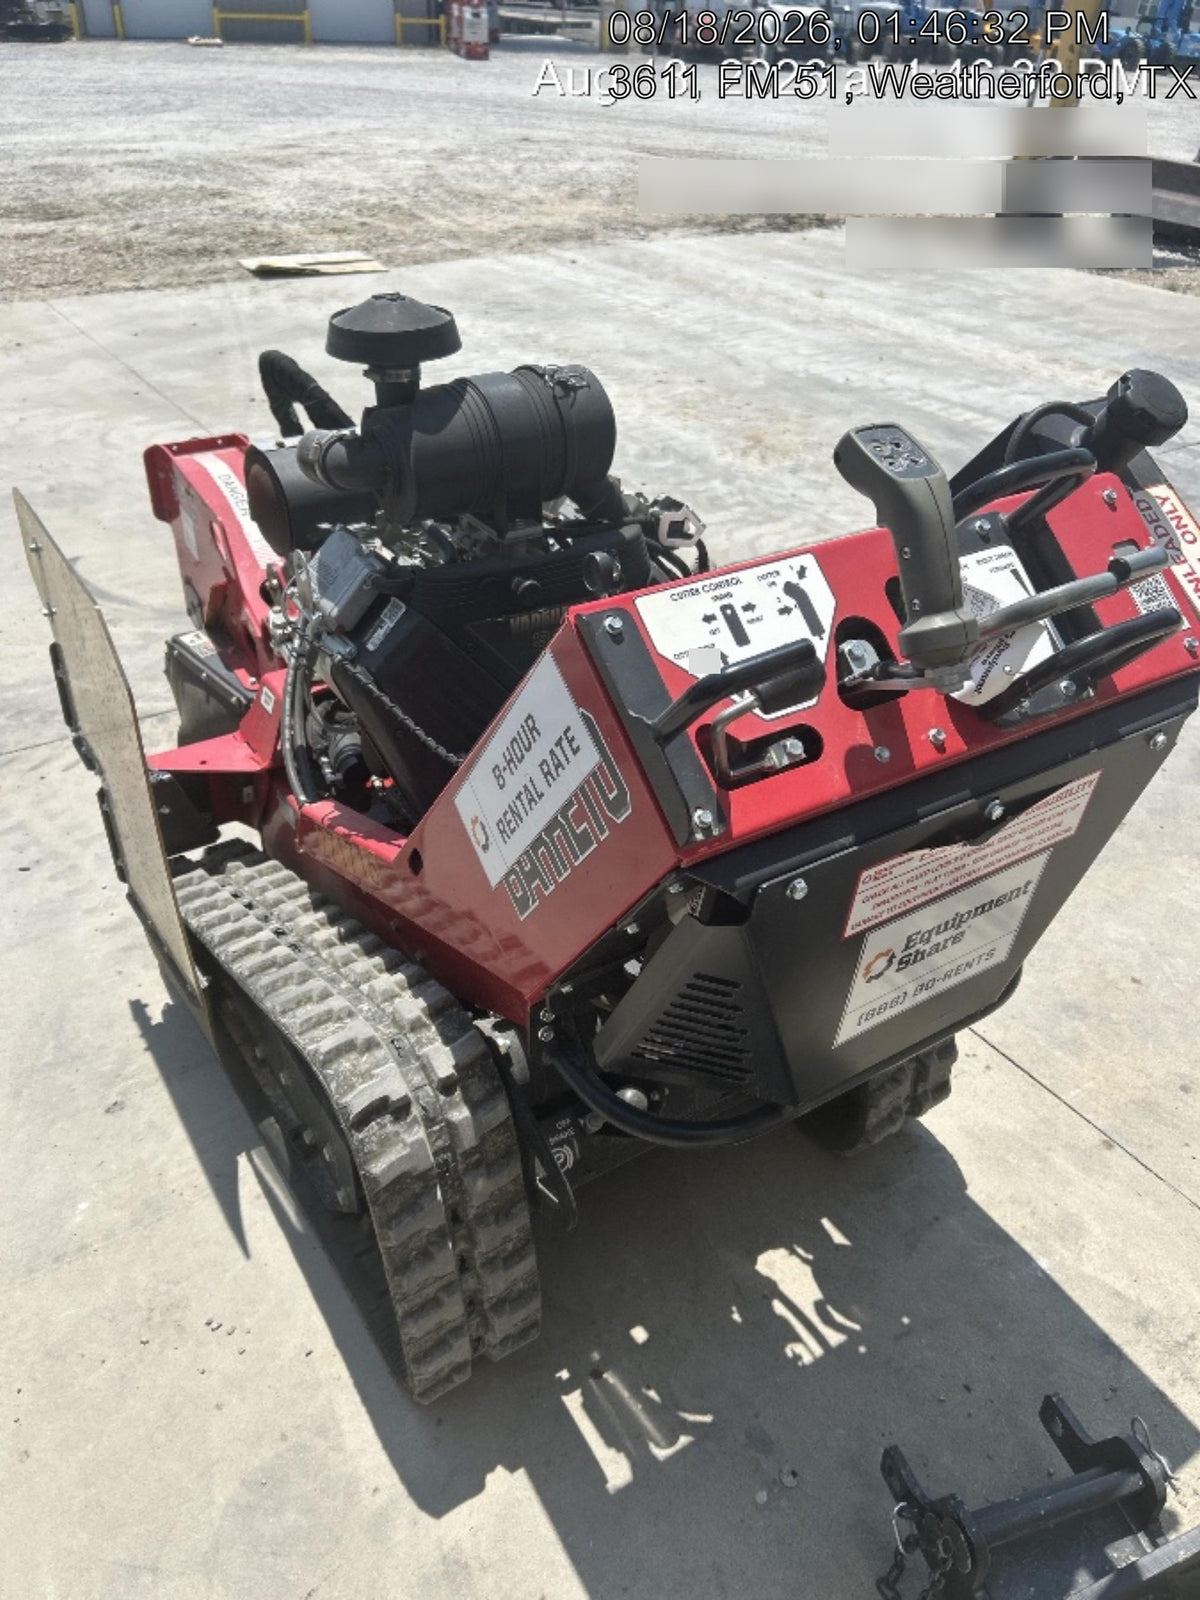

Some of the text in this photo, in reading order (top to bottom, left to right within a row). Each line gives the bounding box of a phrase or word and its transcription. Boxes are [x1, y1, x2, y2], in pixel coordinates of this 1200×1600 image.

[1155, 494, 1198, 545] ONLY
[491, 712, 542, 791] 8-HOUR
[495, 724, 581, 846] RENTAL RATE
[895, 930, 966, 974] Share
[903, 879, 1034, 953] Equipment
[857, 947, 997, 1027] (888) 80-RENTS
